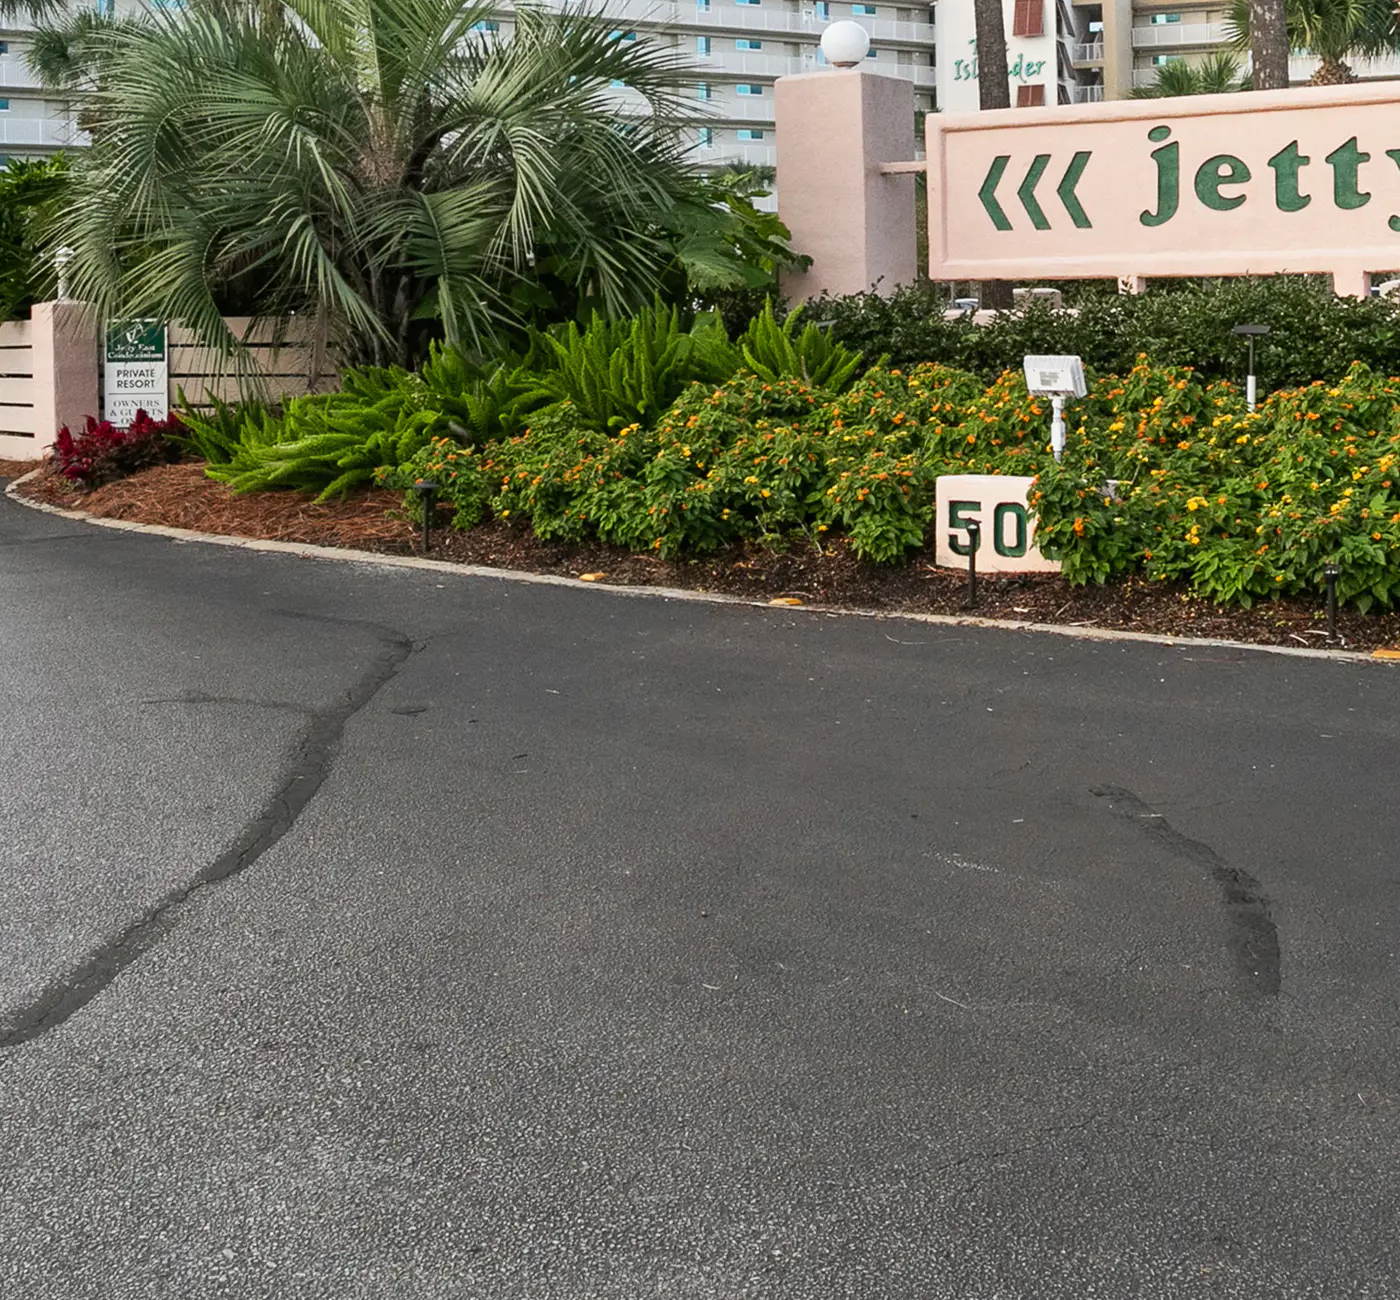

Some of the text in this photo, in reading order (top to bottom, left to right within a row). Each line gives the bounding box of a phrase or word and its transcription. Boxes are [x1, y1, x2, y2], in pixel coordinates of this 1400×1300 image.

[953, 53, 1046, 83] Islder
[1140, 125, 1400, 233] jett
[116, 369, 156, 378] PRIVATE
[116, 379, 156, 389] RESORT
[113, 399, 160, 407] OWNERS
